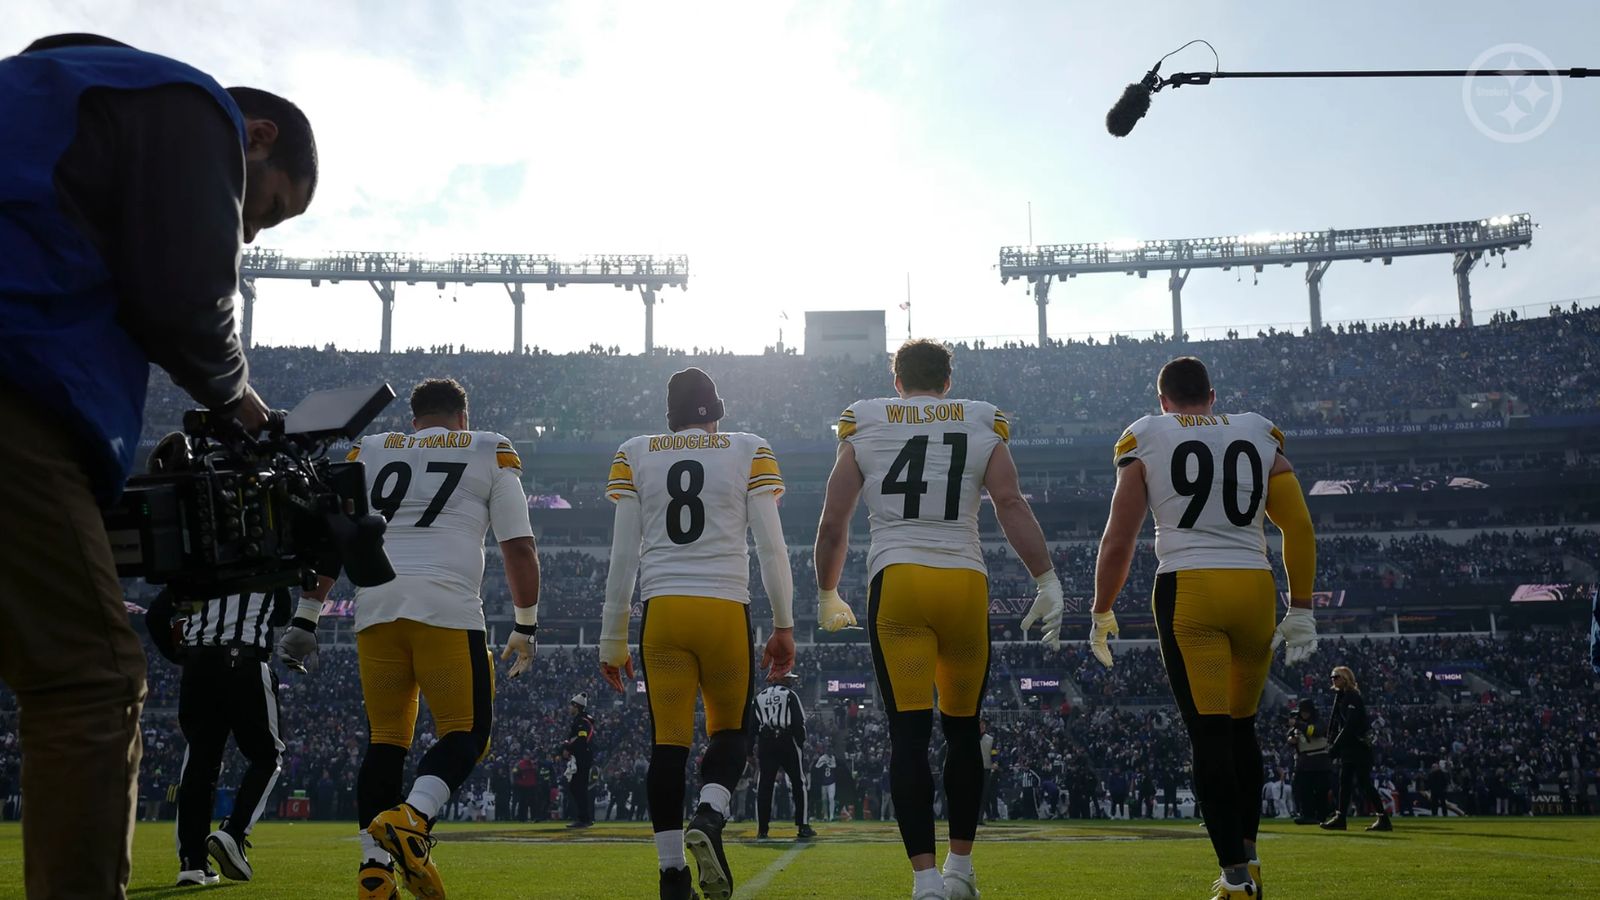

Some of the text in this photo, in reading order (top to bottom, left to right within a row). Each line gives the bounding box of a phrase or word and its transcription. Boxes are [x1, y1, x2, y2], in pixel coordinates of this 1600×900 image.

[886, 403, 965, 424] WILSON
[1375, 425, 1395, 434] 2012
[1481, 420, 1502, 429] 2024
[384, 432, 472, 449] HEYWARD
[649, 433, 731, 452] RODGERS
[1031, 438, 1050, 446] 2000
[881, 432, 968, 521] 41
[1171, 440, 1264, 529] 90
[370, 461, 468, 528] 97
[666, 459, 705, 545] 8
[765, 695, 781, 706] 49
[824, 767, 832, 778] 8
